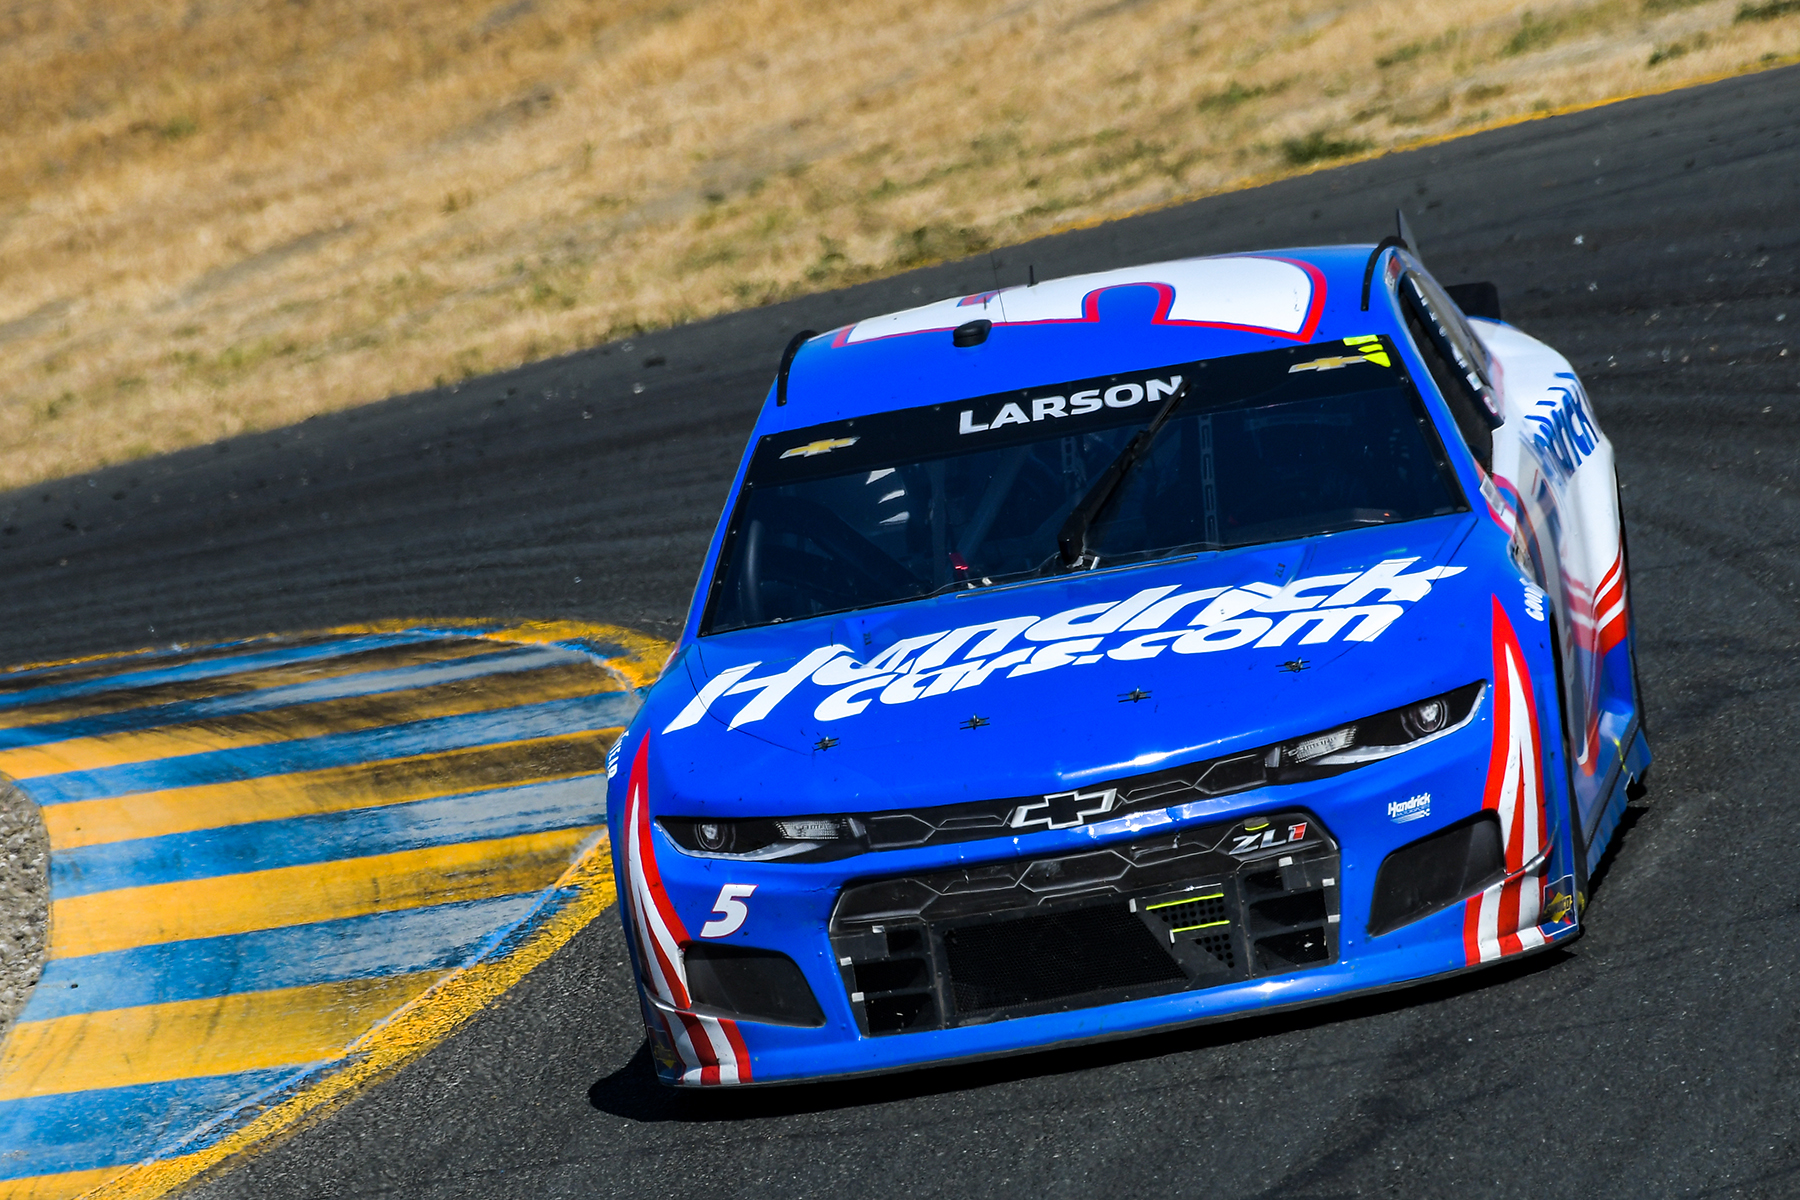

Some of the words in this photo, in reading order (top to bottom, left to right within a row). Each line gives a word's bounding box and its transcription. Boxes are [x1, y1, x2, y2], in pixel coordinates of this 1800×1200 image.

[959, 375, 1183, 435] LARSON
[662, 556, 1468, 735] Hendrick
[813, 603, 1405, 722] cars.com
[1387, 792, 1431, 818] Hendrick
[1228, 821, 1308, 855] ZL1
[699, 882, 759, 939] 5
